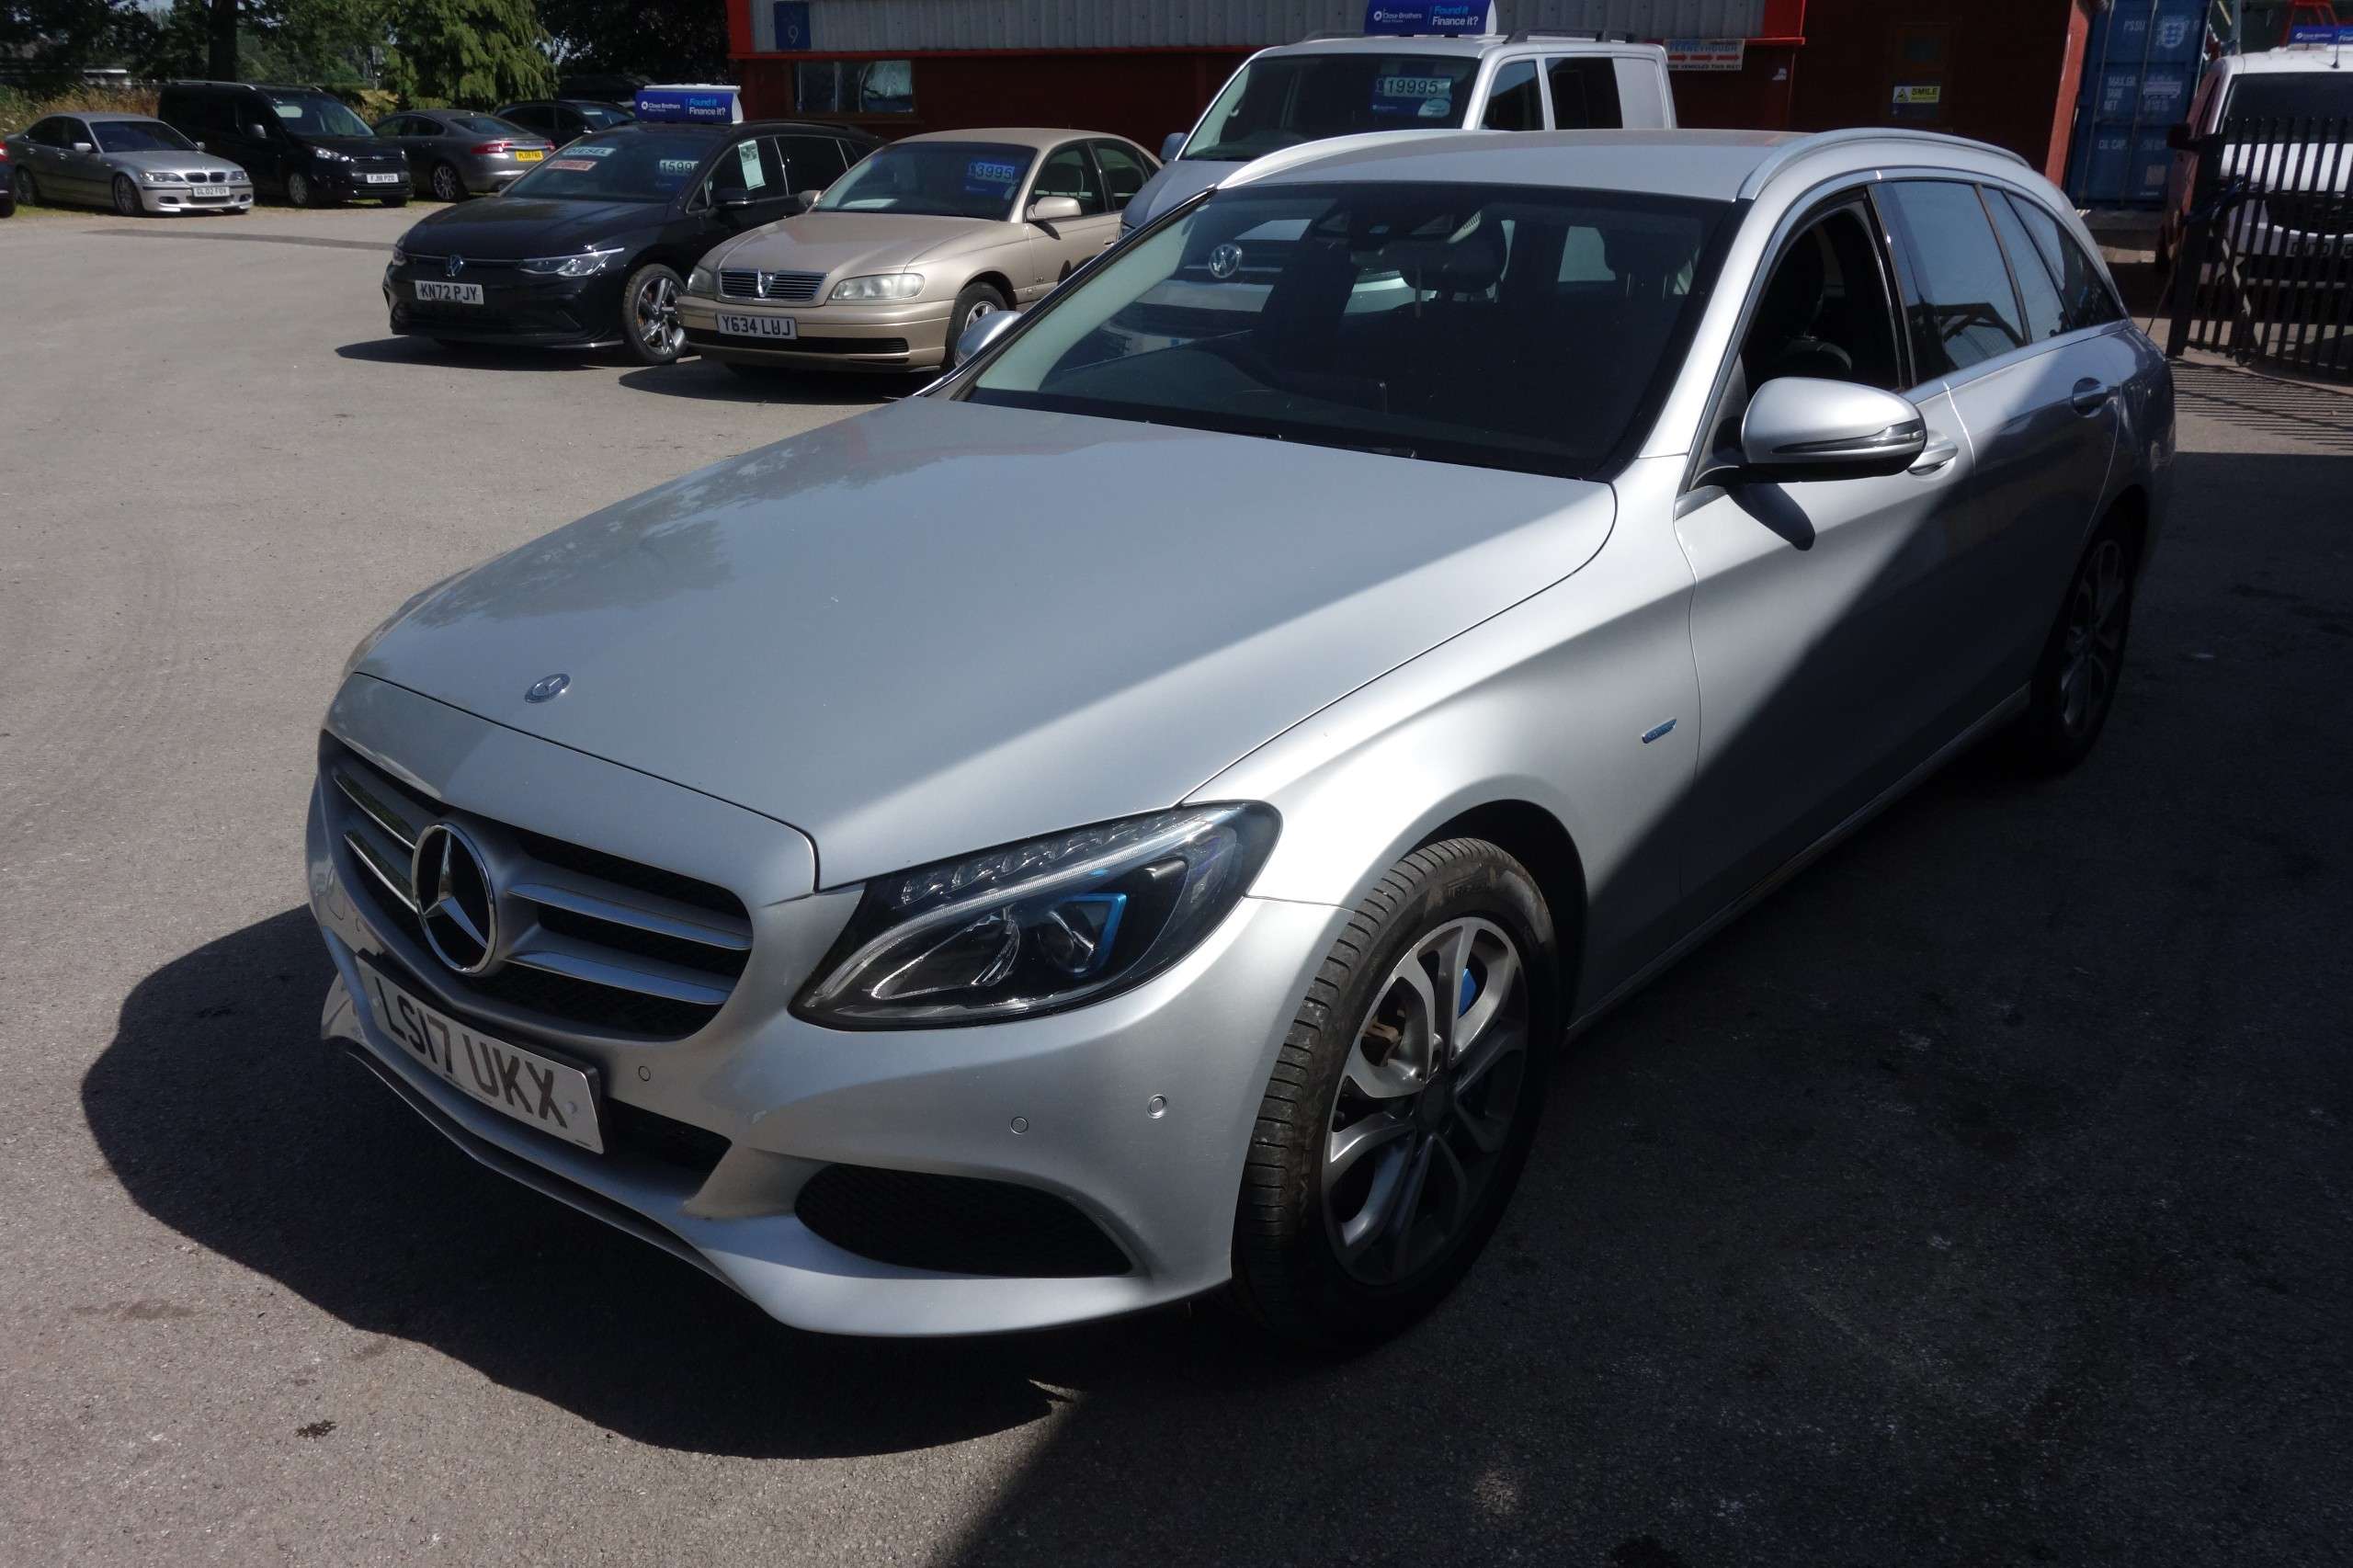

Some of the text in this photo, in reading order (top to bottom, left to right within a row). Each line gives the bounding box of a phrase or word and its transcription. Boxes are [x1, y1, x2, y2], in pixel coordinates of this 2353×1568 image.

[1434, 6, 1469, 14] Found it
[1432, 16, 1479, 26] Finance it?
[788, 25, 799, 44] 9
[1912, 87, 1938, 96] SMILE
[689, 97, 712, 107] Found
[688, 107, 726, 117] Finance it?
[420, 282, 477, 301] KN72 PJY
[722, 315, 790, 335] Y634 LUJ
[375, 977, 568, 1129] LS17 UKX
